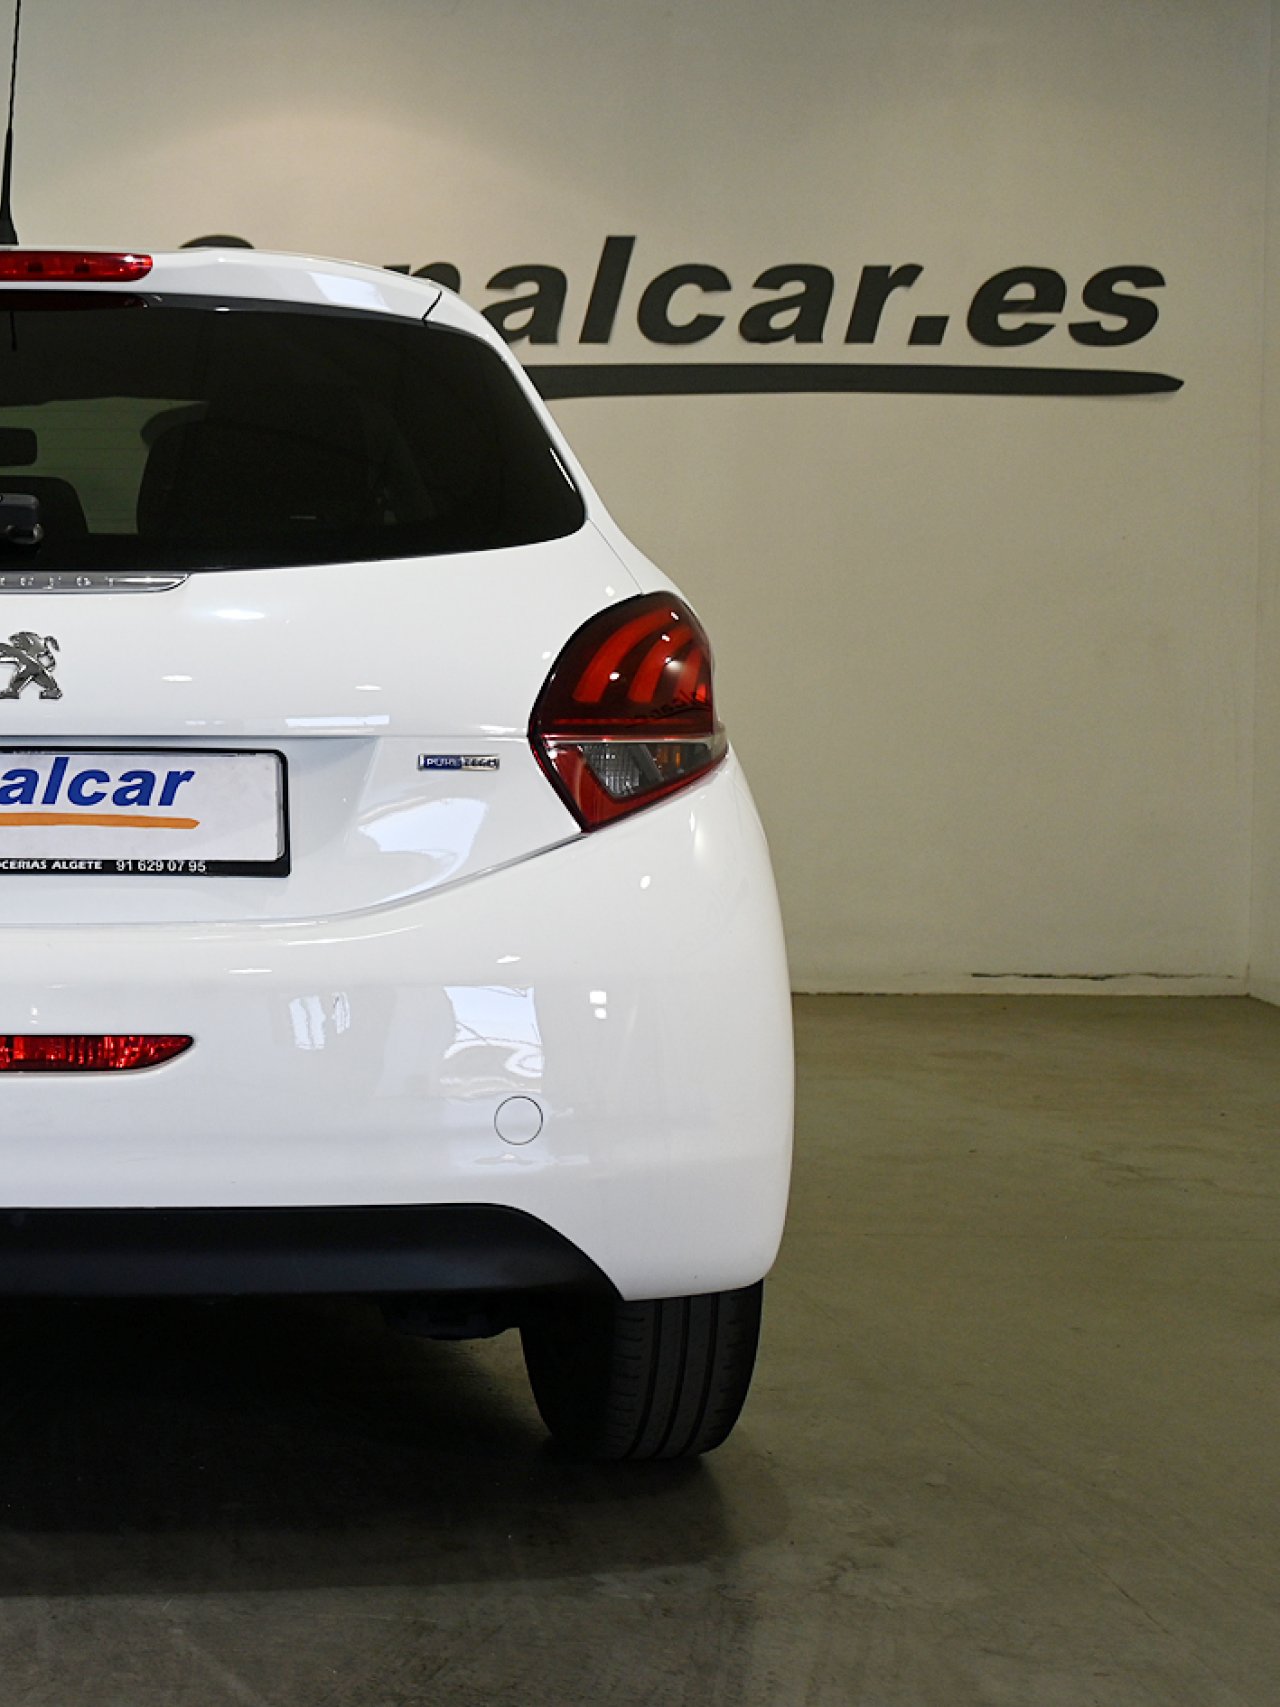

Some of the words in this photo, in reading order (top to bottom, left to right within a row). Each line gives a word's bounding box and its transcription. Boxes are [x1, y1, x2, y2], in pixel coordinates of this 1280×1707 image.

[180, 234, 1167, 347] alcar.es
[51, 860, 103, 871] ALGETE
[115, 860, 133, 872] 91
[137, 860, 164, 872] 629
[168, 860, 185, 872] 07
[188, 860, 207, 873] 95
